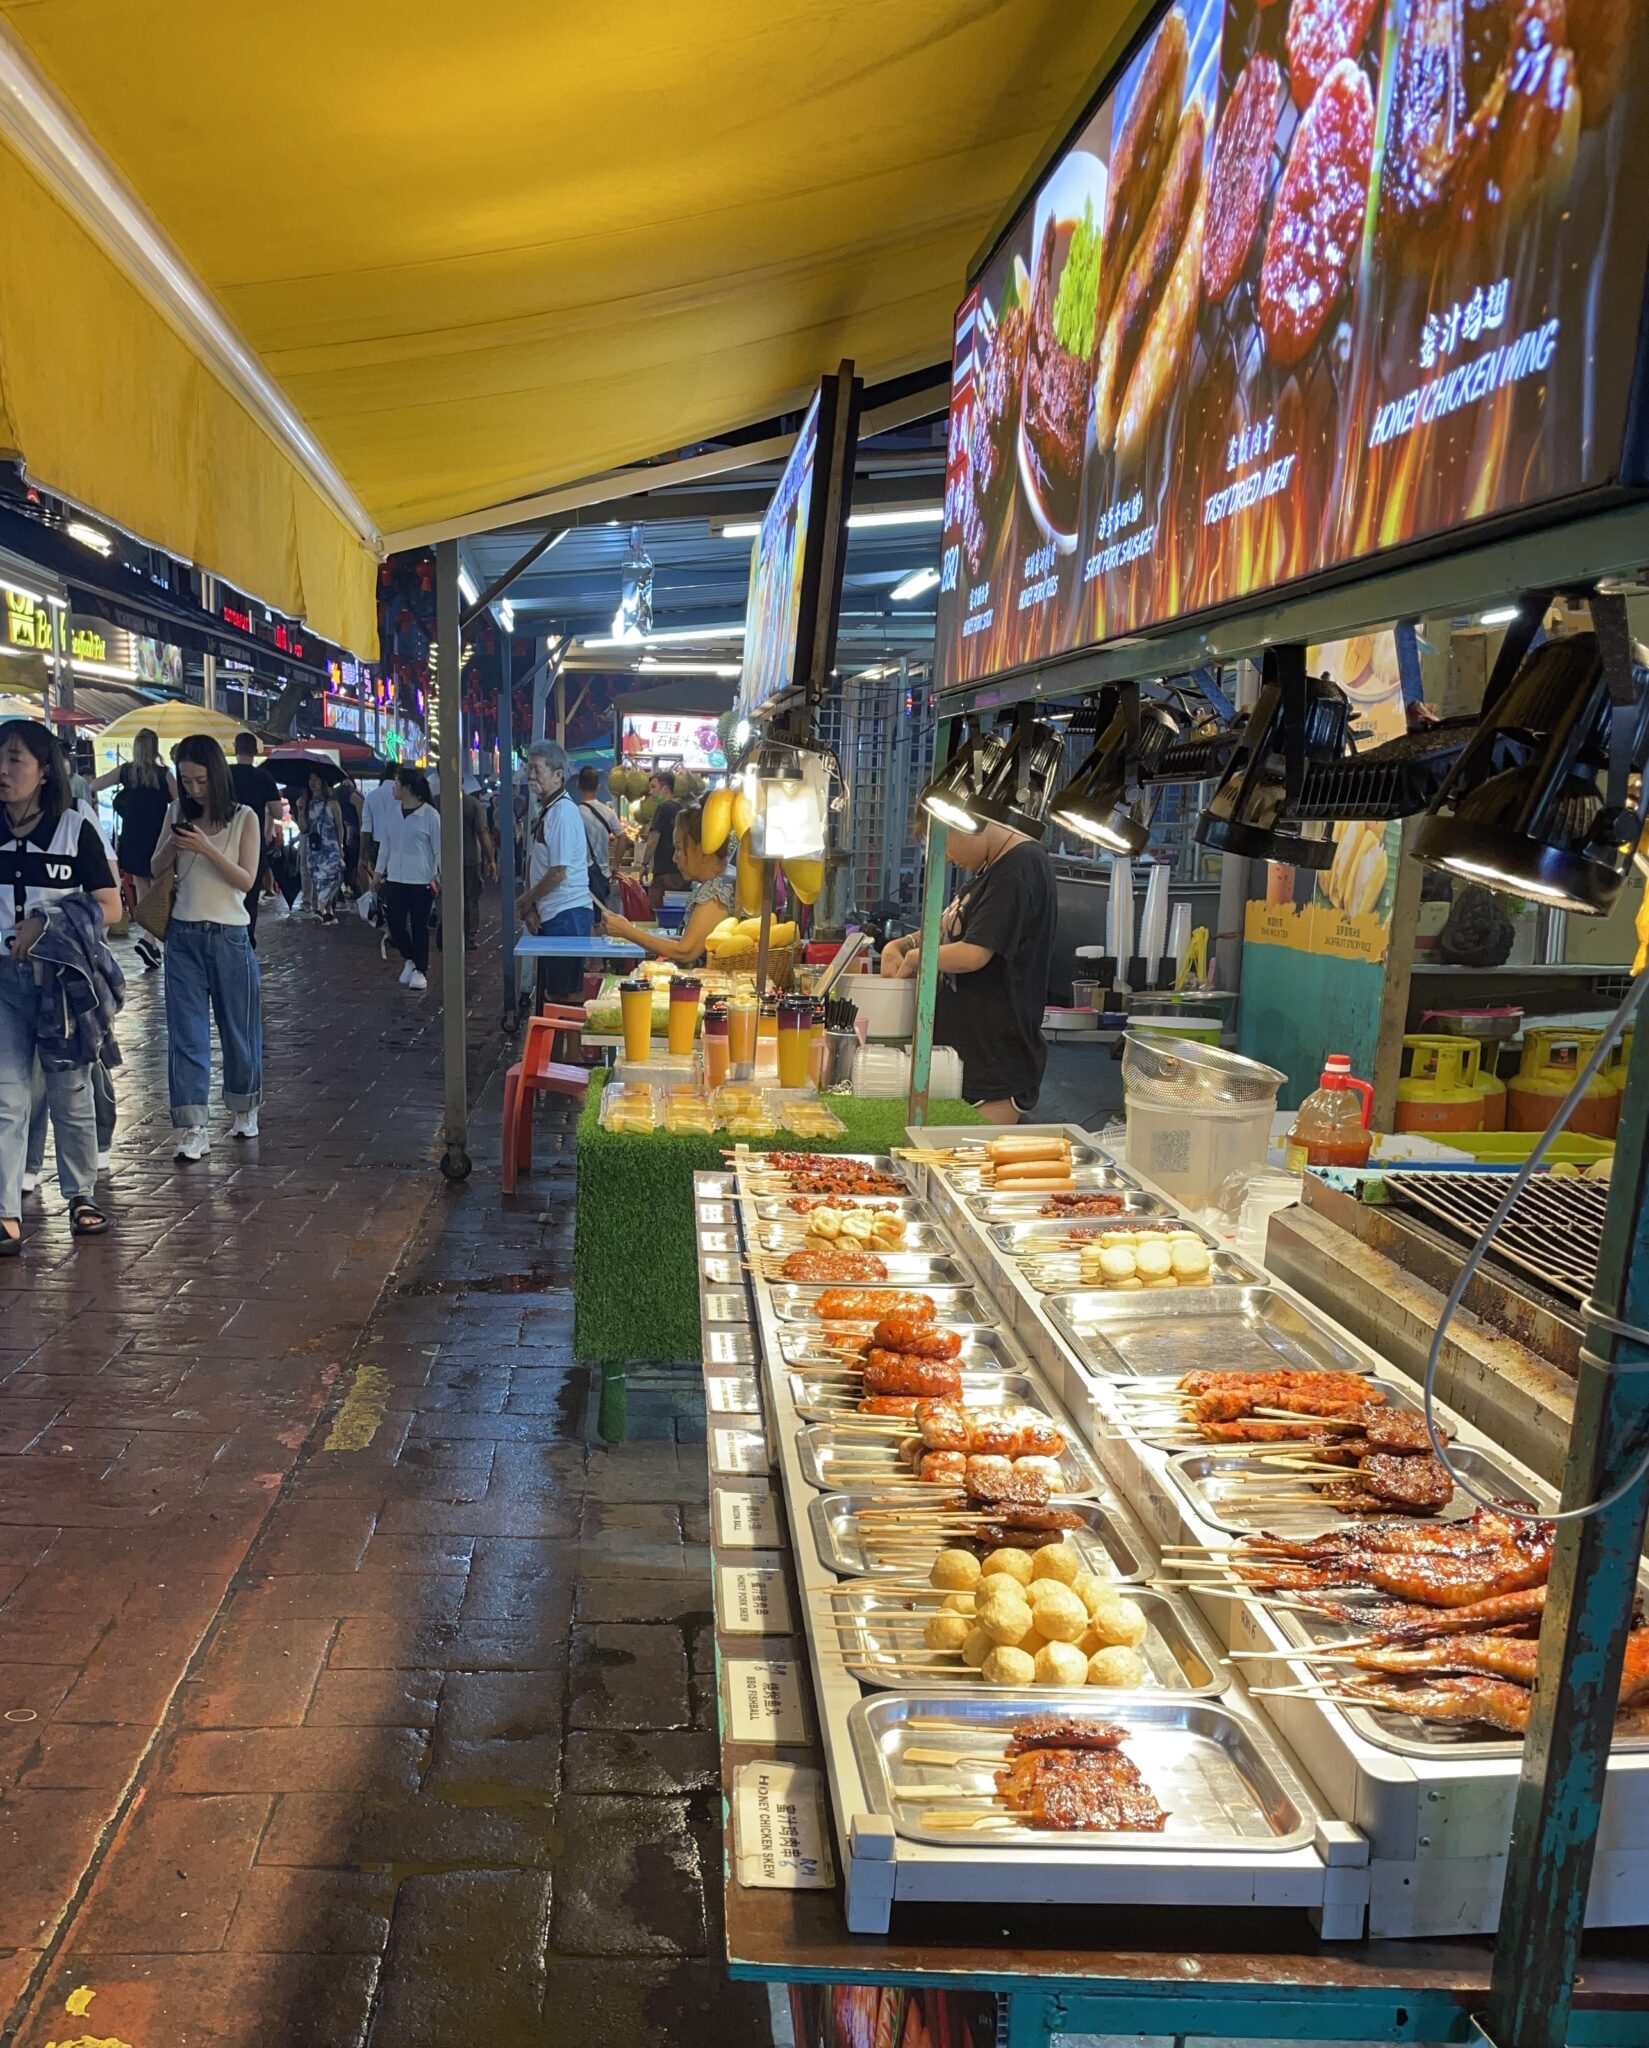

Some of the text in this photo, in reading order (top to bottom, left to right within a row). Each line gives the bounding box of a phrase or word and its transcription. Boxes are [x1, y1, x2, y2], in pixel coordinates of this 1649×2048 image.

[1420, 278, 1509, 367] 蜜汁鸡翅
[1368, 318, 1560, 448] HONEY CHICKEN WING
[1203, 454, 1295, 526] TASTY DRIED MEAT
[941, 543, 960, 594] BBQ
[1101, 543, 1122, 573] PORK
[1119, 524, 1155, 567] SAUSAGE
[46, 863, 72, 880] VD
[732, 1505, 743, 1531] BACON BALL
[737, 1574, 750, 1623] HONEY PORK SKEW
[746, 1675, 760, 1721] BBQ FISHBALL
[758, 1774, 776, 1880] HONEY CHICKEN SKEW
[776, 1803, 802, 1858] 蜜汁鸡肉串
[778, 1859, 799, 1870] 6
[800, 1857, 818, 1877] RM
